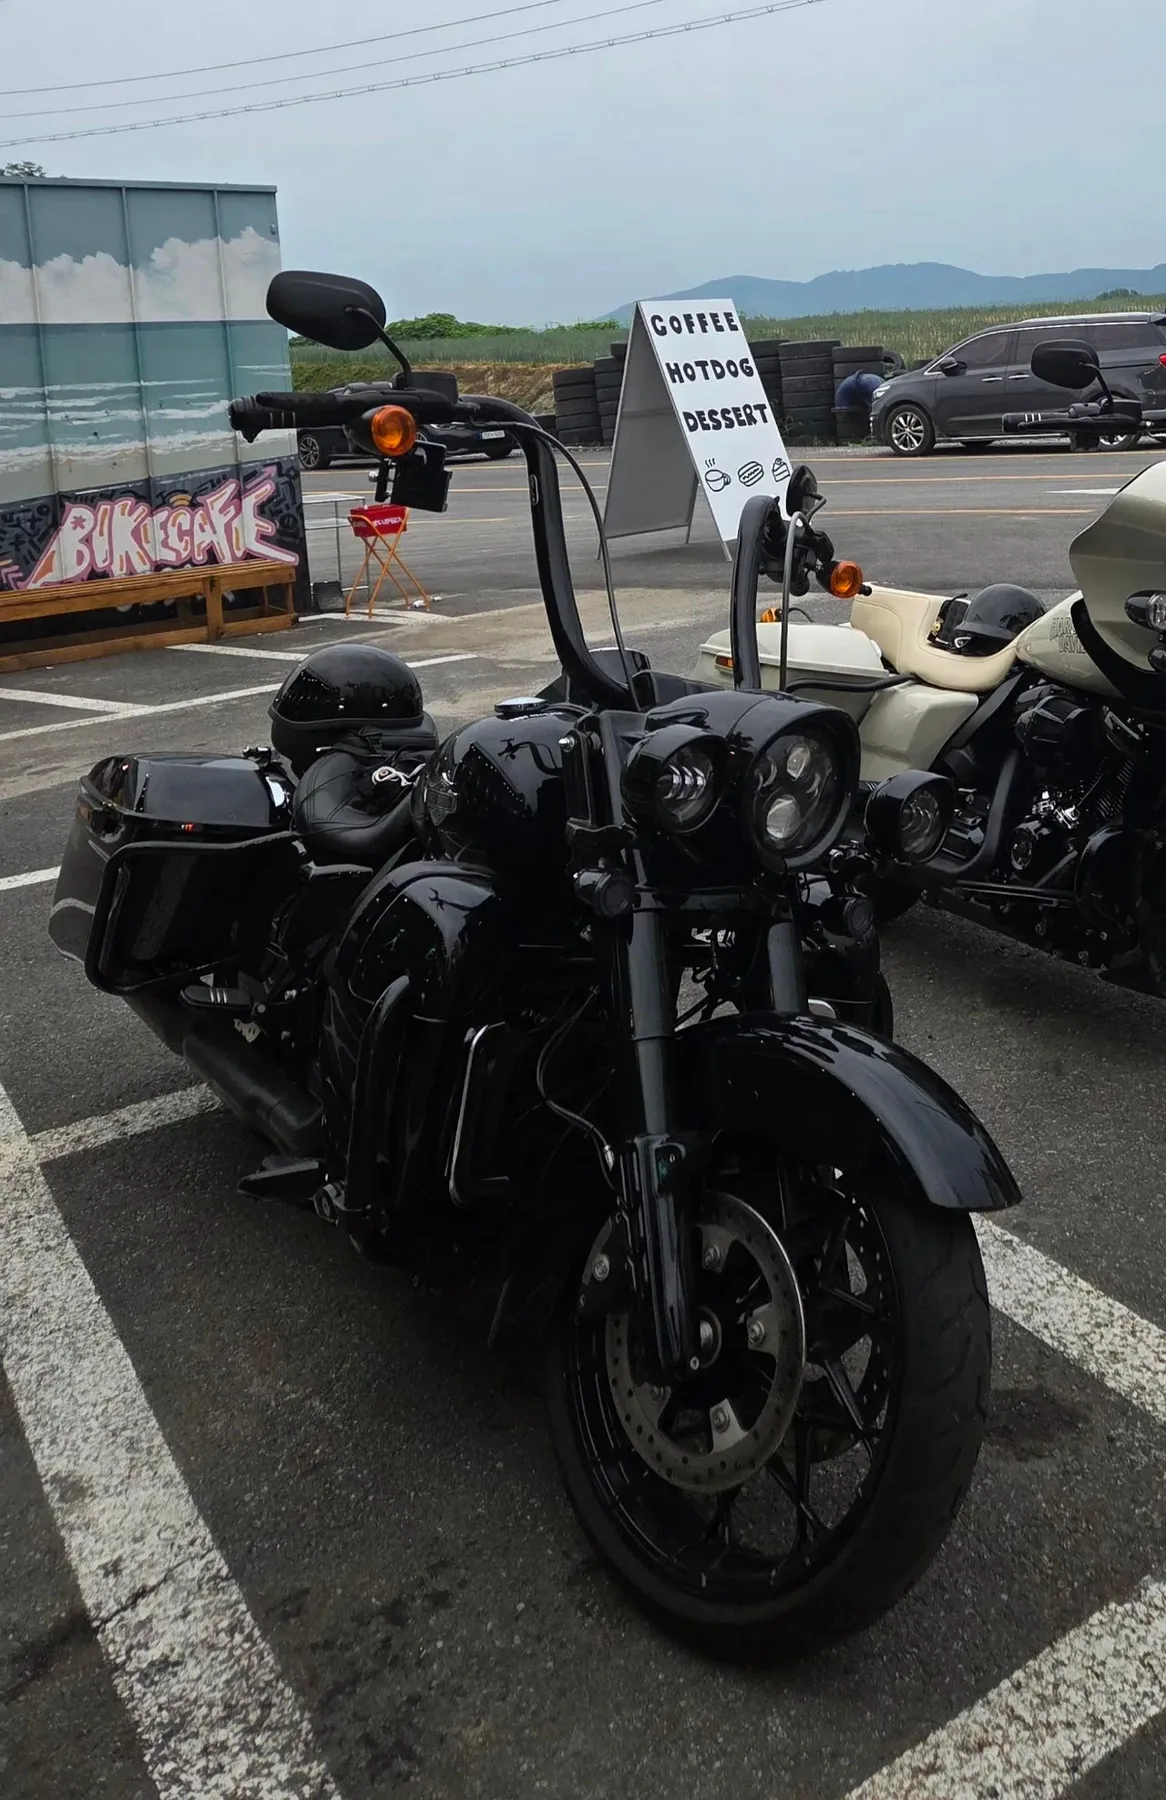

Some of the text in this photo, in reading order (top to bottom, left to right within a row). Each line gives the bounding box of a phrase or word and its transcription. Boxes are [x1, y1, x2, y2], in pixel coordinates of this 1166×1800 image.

[650, 311, 739, 337] COFFEE
[665, 357, 755, 383] HOTDOG
[682, 403, 769, 432] DESSERT
